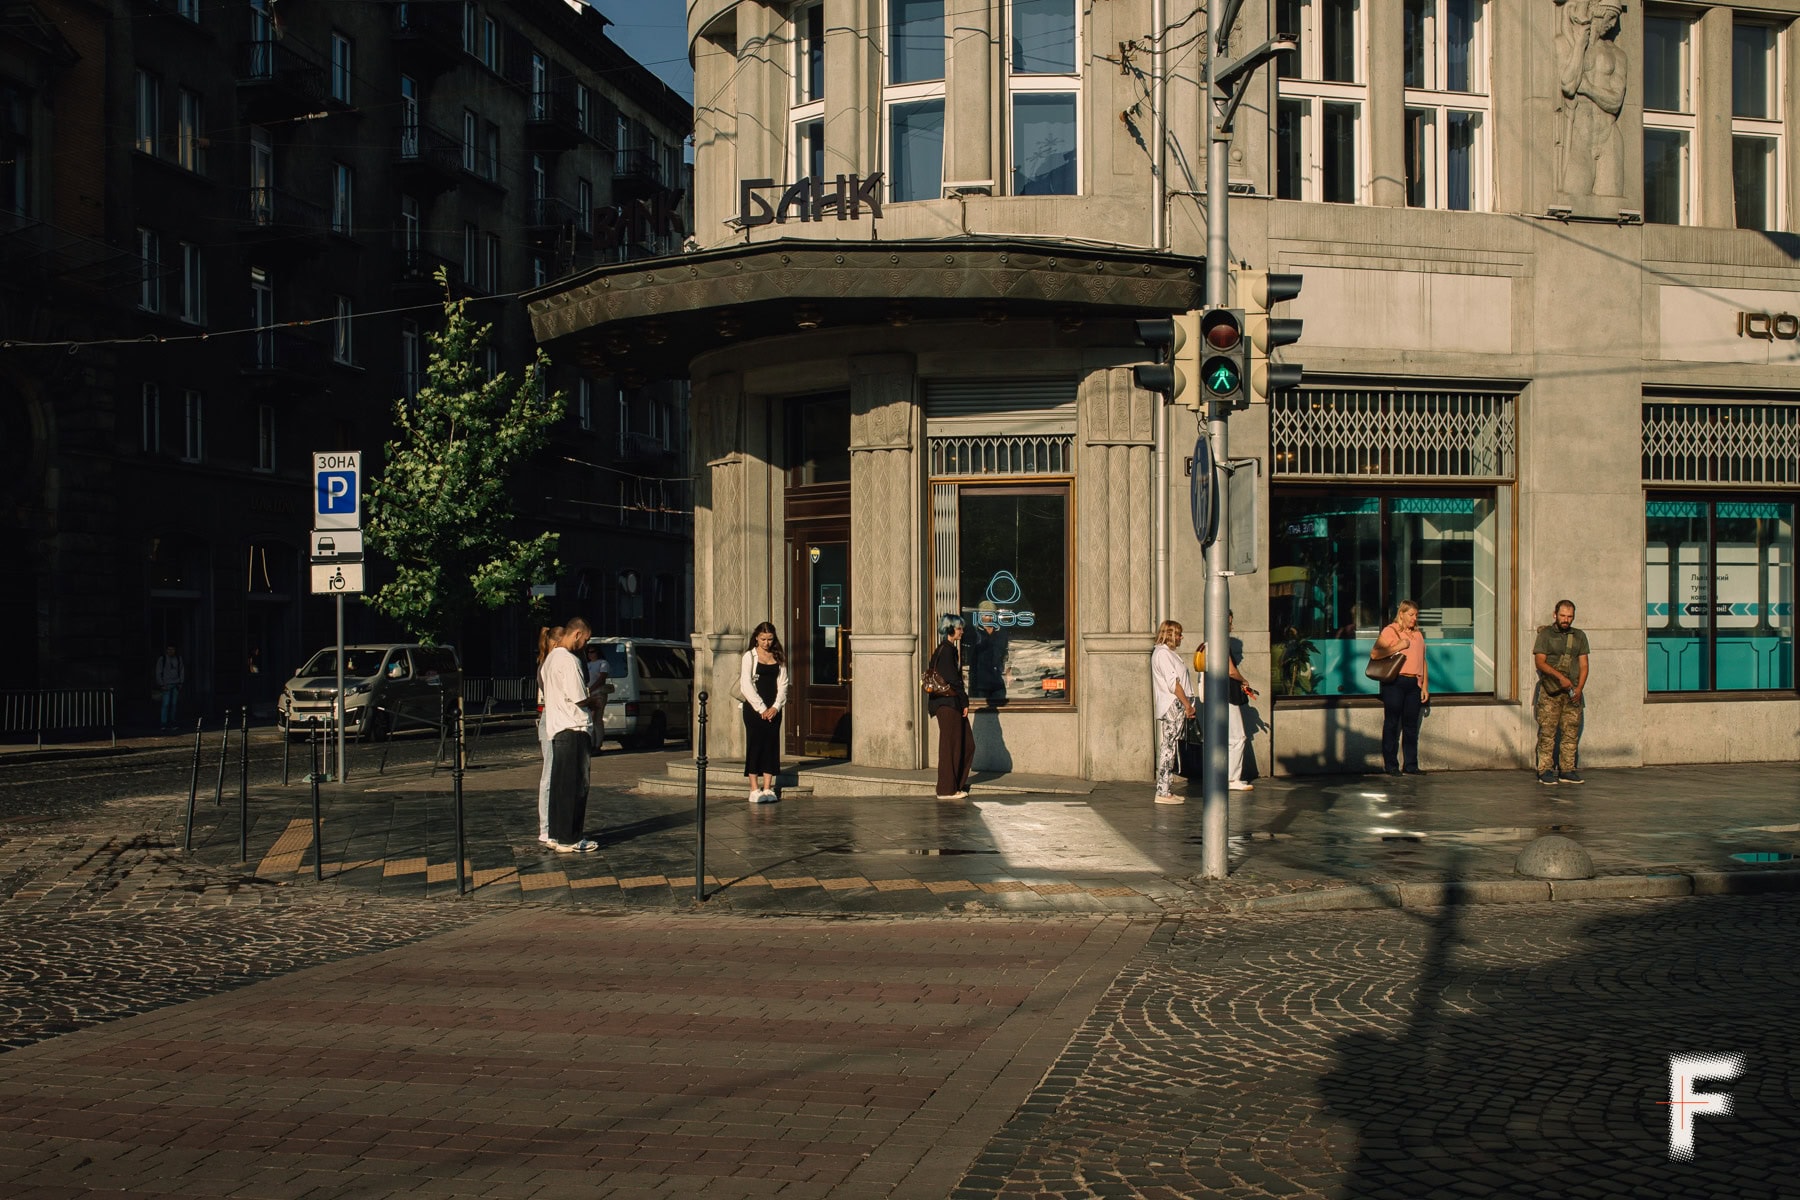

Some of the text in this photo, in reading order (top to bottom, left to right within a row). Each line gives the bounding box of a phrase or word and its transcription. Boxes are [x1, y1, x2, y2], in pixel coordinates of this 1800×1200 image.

[740, 172, 885, 225] БАНК
[592, 188, 686, 250] BANK
[1737, 311, 1800, 343] IQO
[318, 455, 356, 469] ЗОНА
[327, 476, 349, 509] P
[972, 611, 1035, 629] IQOS
